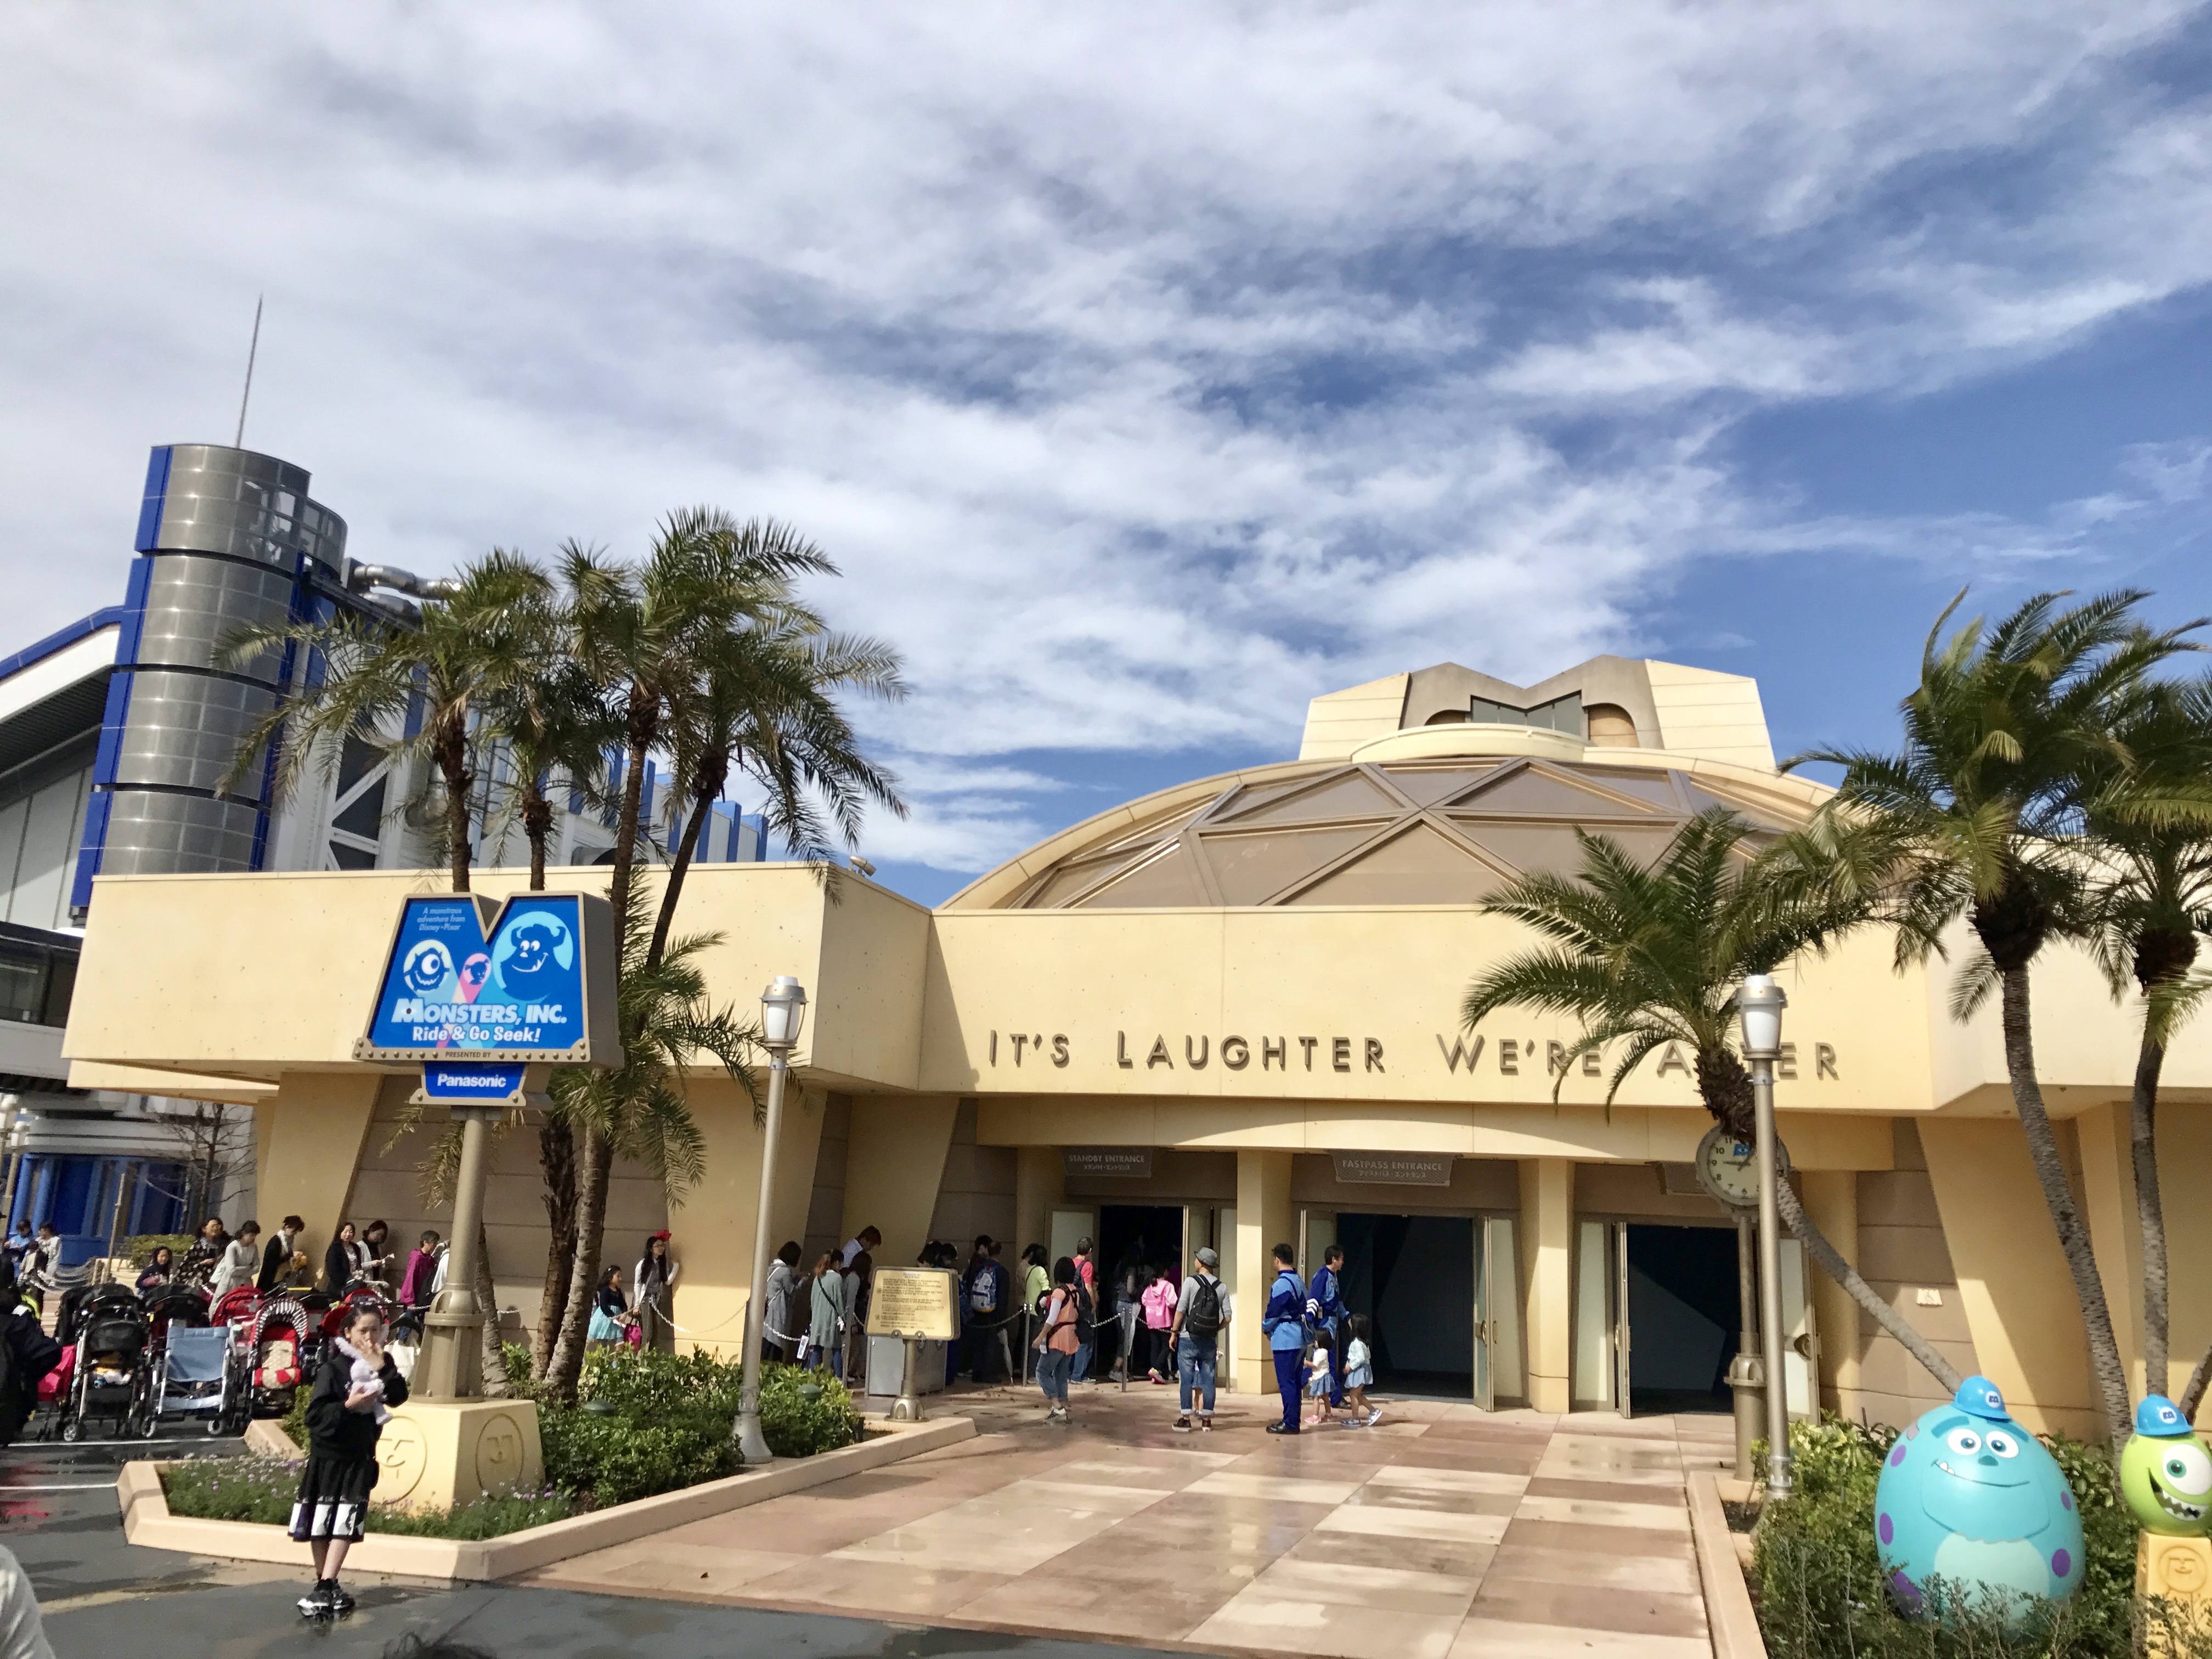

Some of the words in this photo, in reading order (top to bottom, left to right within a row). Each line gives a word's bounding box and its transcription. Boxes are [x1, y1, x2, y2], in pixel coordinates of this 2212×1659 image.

[417, 915, 449, 923] adventure
[450, 914, 465, 922] from
[525, 1004, 567, 1024] INC.
[413, 1026, 448, 1041] Ride
[451, 1025, 466, 1041] &
[469, 1026, 489, 1041] Go
[493, 1027, 541, 1042] Seek!
[988, 1029, 1070, 1068] IT'S
[1116, 1030, 1386, 1074] LAUGHTER
[1435, 1034, 1602, 1077] WE'RE
[1656, 1039, 1840, 1080] AER
[437, 1073, 506, 1088] Panasonic
[1069, 1154, 1102, 1163] STANDBY
[1105, 1155, 1145, 1163] ENTRANCE
[1342, 1159, 1389, 1170] FASTPASS
[1391, 1161, 1443, 1171] ENTRANCE
